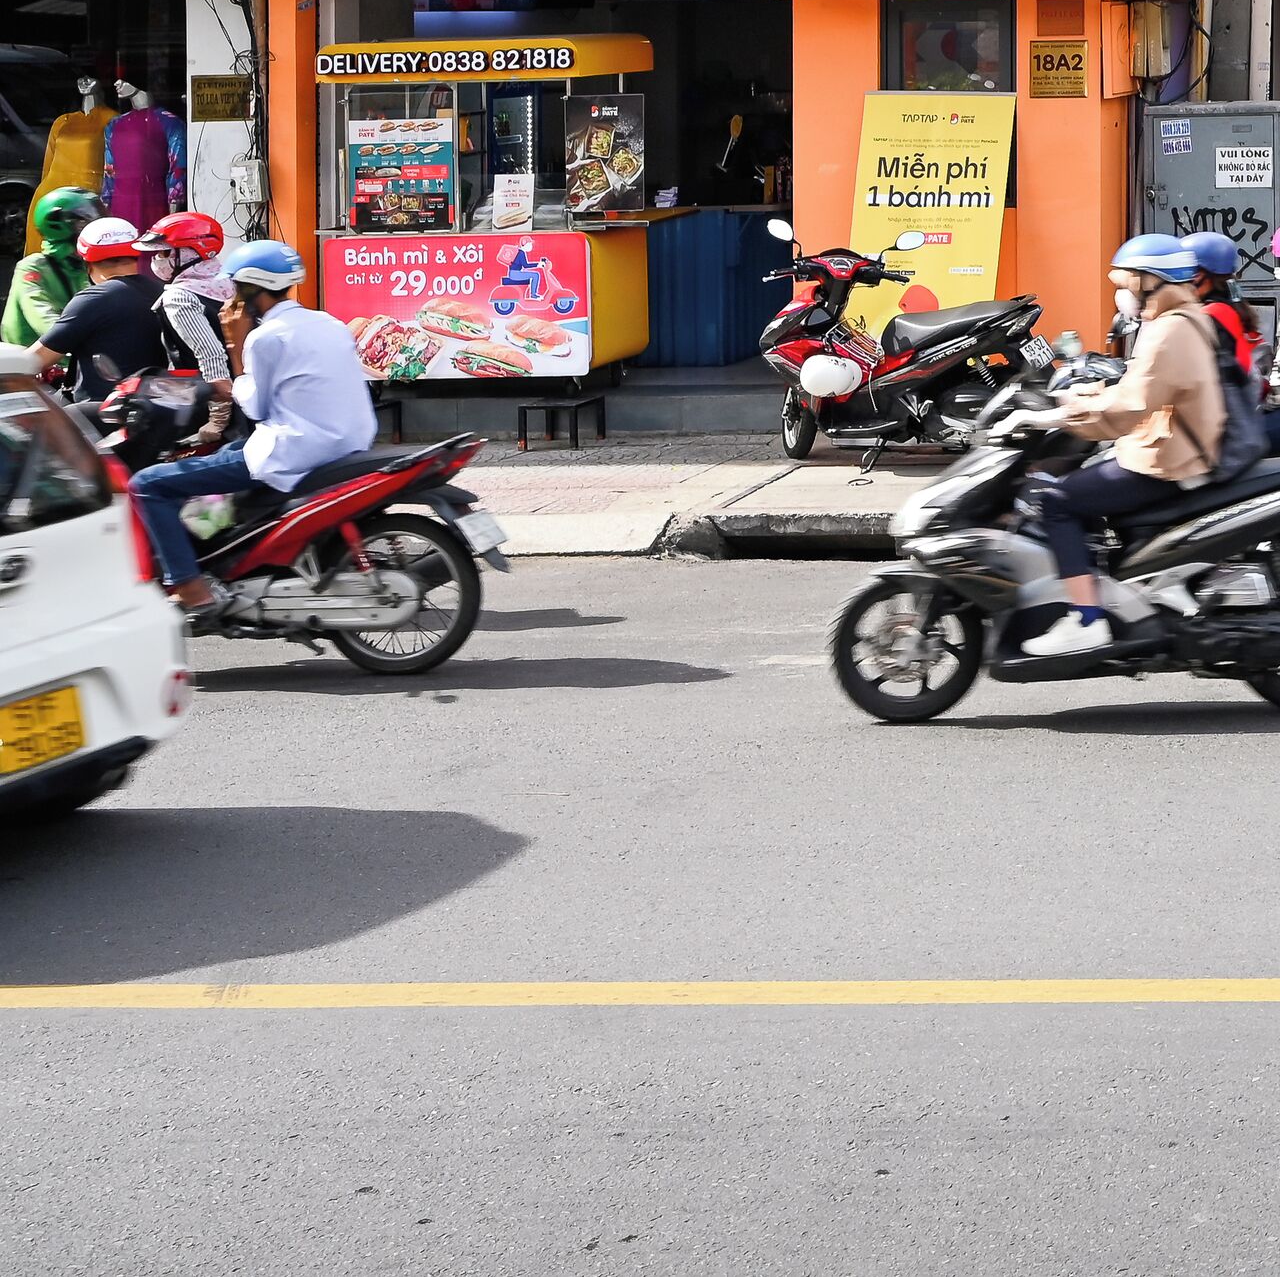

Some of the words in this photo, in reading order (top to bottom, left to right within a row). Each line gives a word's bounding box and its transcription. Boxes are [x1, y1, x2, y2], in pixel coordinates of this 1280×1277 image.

[427, 51, 487, 73] 0838
[491, 49, 521, 70] 82
[522, 48, 573, 69] 1818
[1032, 53, 1084, 72] 18A2
[901, 113, 939, 124] TAPTAP
[1220, 150, 1238, 159] VUI
[876, 152, 940, 180] Miễn
[945, 156, 989, 185] phí
[1218, 161, 1245, 172] KHÔNG
[1256, 160, 1272, 171] RÁC
[1229, 173, 1244, 185] TẠI
[1246, 173, 1265, 184] ĐÂY
[867, 185, 881, 208] 1
[887, 184, 951, 209] bánh
[958, 185, 992, 209] mì
[344, 245, 397, 266] Bánh
[402, 244, 430, 265] mì
[435, 249, 448, 264] &
[452, 243, 485, 264] Xôi
[345, 272, 367, 285] Chỉ
[368, 272, 384, 285] từ
